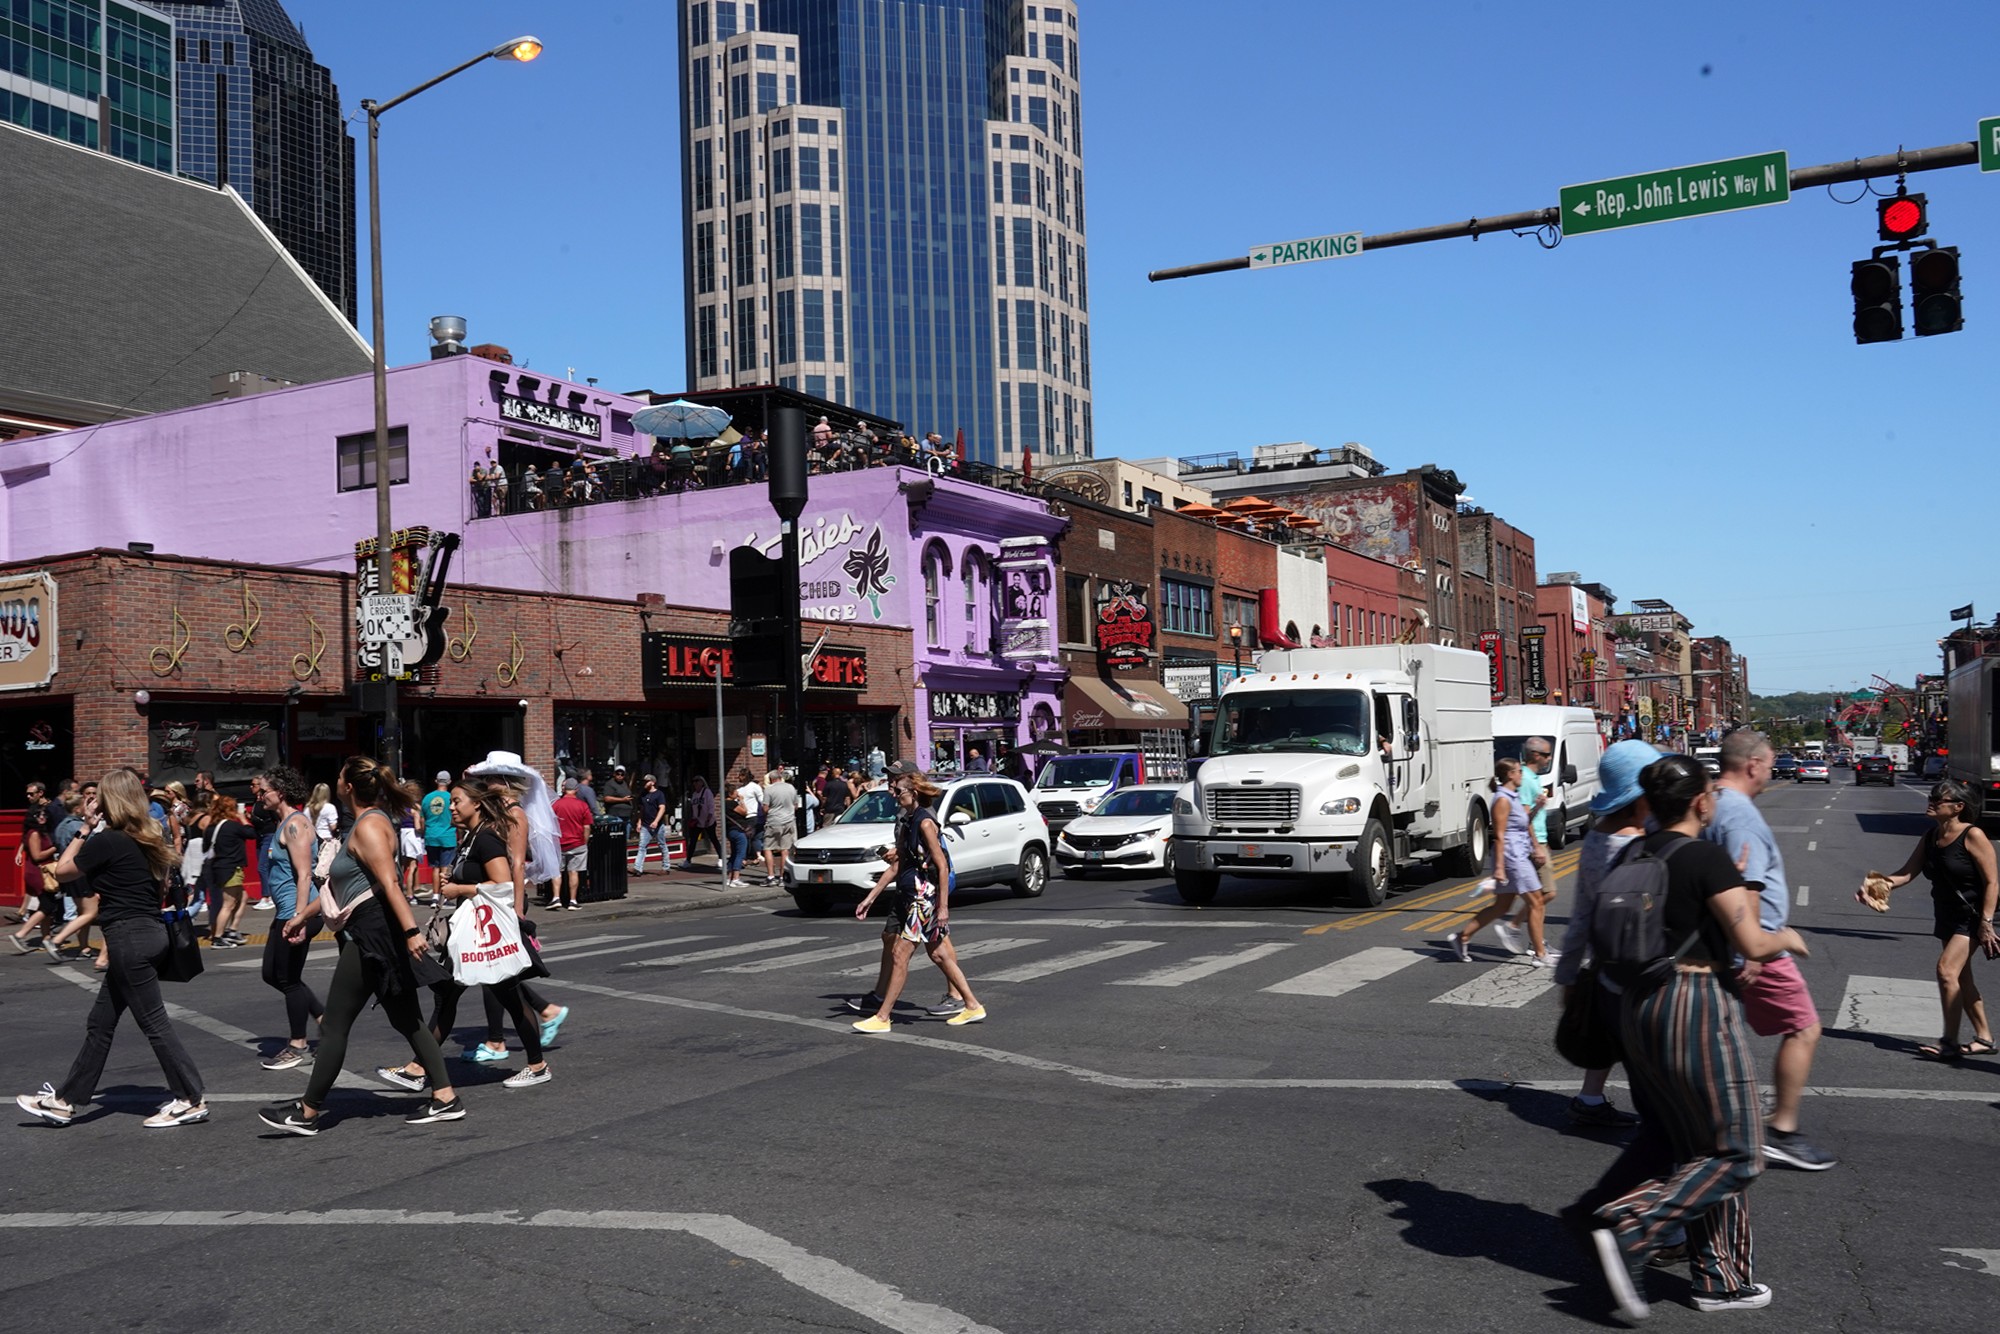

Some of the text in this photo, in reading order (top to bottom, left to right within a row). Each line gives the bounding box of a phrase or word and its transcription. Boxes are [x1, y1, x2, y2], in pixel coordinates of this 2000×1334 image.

[1596, 164, 1777, 219] Rep. John Lewis Way N
[1272, 235, 1358, 264] PARKING
[799, 581, 841, 600] CHID
[369, 597, 406, 606] DIAGONAL
[370, 605, 406, 616] CROSSING
[367, 619, 386, 636] OK
[668, 645, 734, 678] LEGE
[811, 654, 865, 685] GIFTS
[1530, 638, 1540, 688] WHISKEY
[1072, 709, 1104, 721] Second
[1072, 719, 1105, 728] Fiddle
[489, 943, 519, 961] BARN
